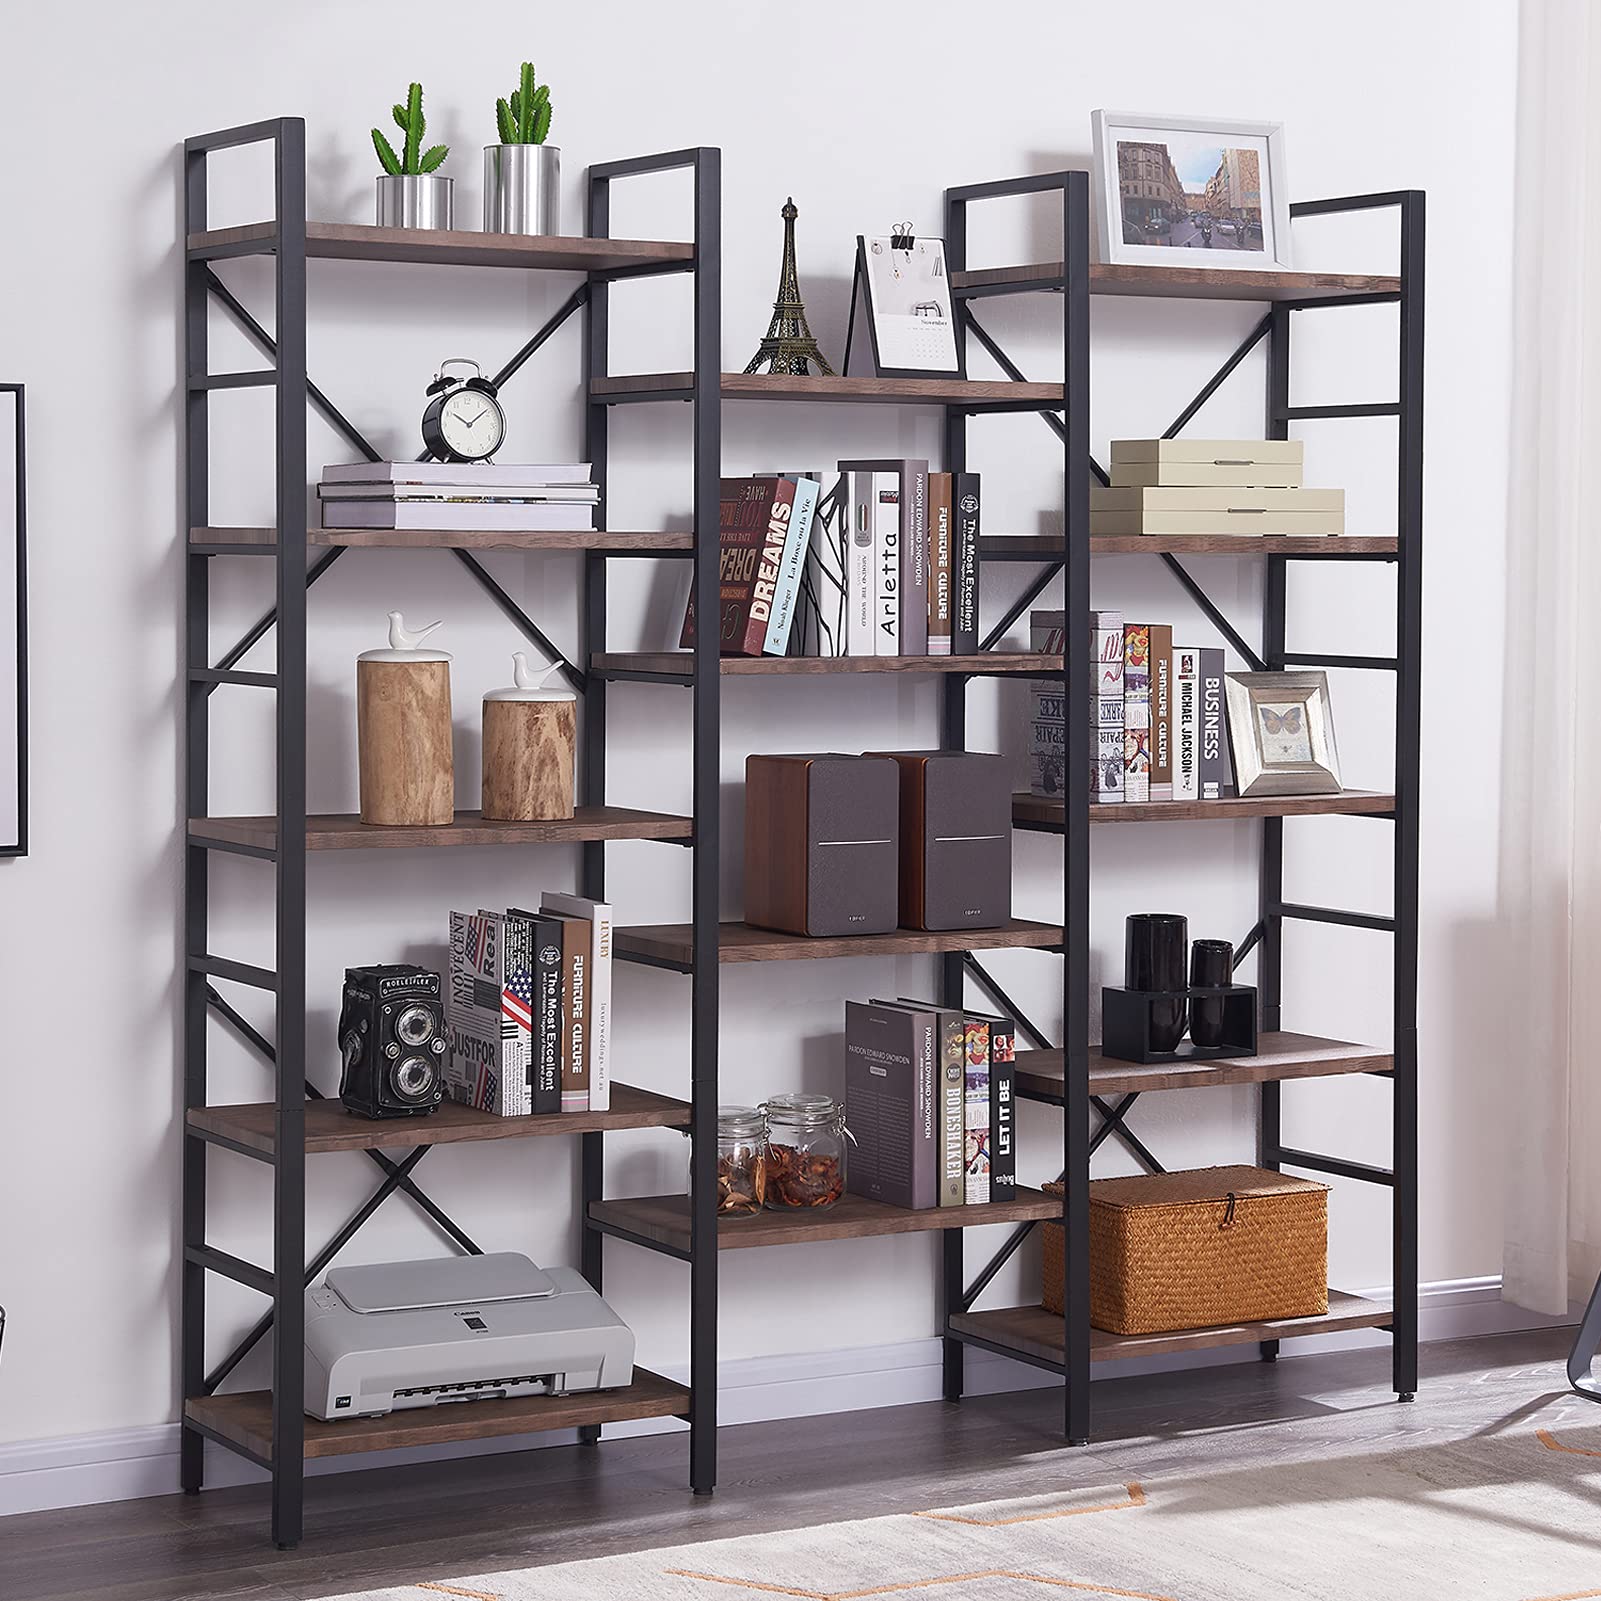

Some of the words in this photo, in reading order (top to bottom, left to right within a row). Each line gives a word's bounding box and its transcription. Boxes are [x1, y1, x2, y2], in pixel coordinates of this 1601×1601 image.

[746, 486, 766, 500] HAVE
[801, 499, 811, 513] Vie
[799, 516, 807, 525] la
[938, 507, 948, 567] FURNITURE
[967, 519, 976, 542] The
[750, 501, 791, 622] DREAMS
[787, 567, 796, 580] La
[790, 541, 801, 564] Boxe
[915, 544, 923, 586] SNOWDEN
[966, 545, 975, 574] Most
[880, 533, 897, 636] Arletta
[938, 571, 948, 620] CULTURE
[964, 577, 975, 632] Excellent
[1158, 659, 1167, 717] FURNITURE
[1181, 683, 1193, 725] MICHAEL
[1204, 677, 1220, 760] BUSINESS
[1158, 721, 1167, 768] CULTURE
[1181, 728, 1193, 773] JACKSON
[600, 920, 609, 958] LUXURY
[547, 971, 558, 995] The
[573, 955, 583, 1019] FURNITURE
[546, 999, 557, 1030] Most
[545, 1033, 556, 1091] Excellent
[572, 1023, 583, 1074] CULTURE
[848, 1044, 867, 1055] PARDON
[866, 1048, 886, 1060] EDWARD
[885, 1052, 910, 1065] SNOWDEN
[999, 1079, 1010, 1102] BE
[946, 1087, 961, 1179] BONESHAKER
[999, 1105, 1010, 1121] IT
[999, 1125, 1010, 1155] LET
